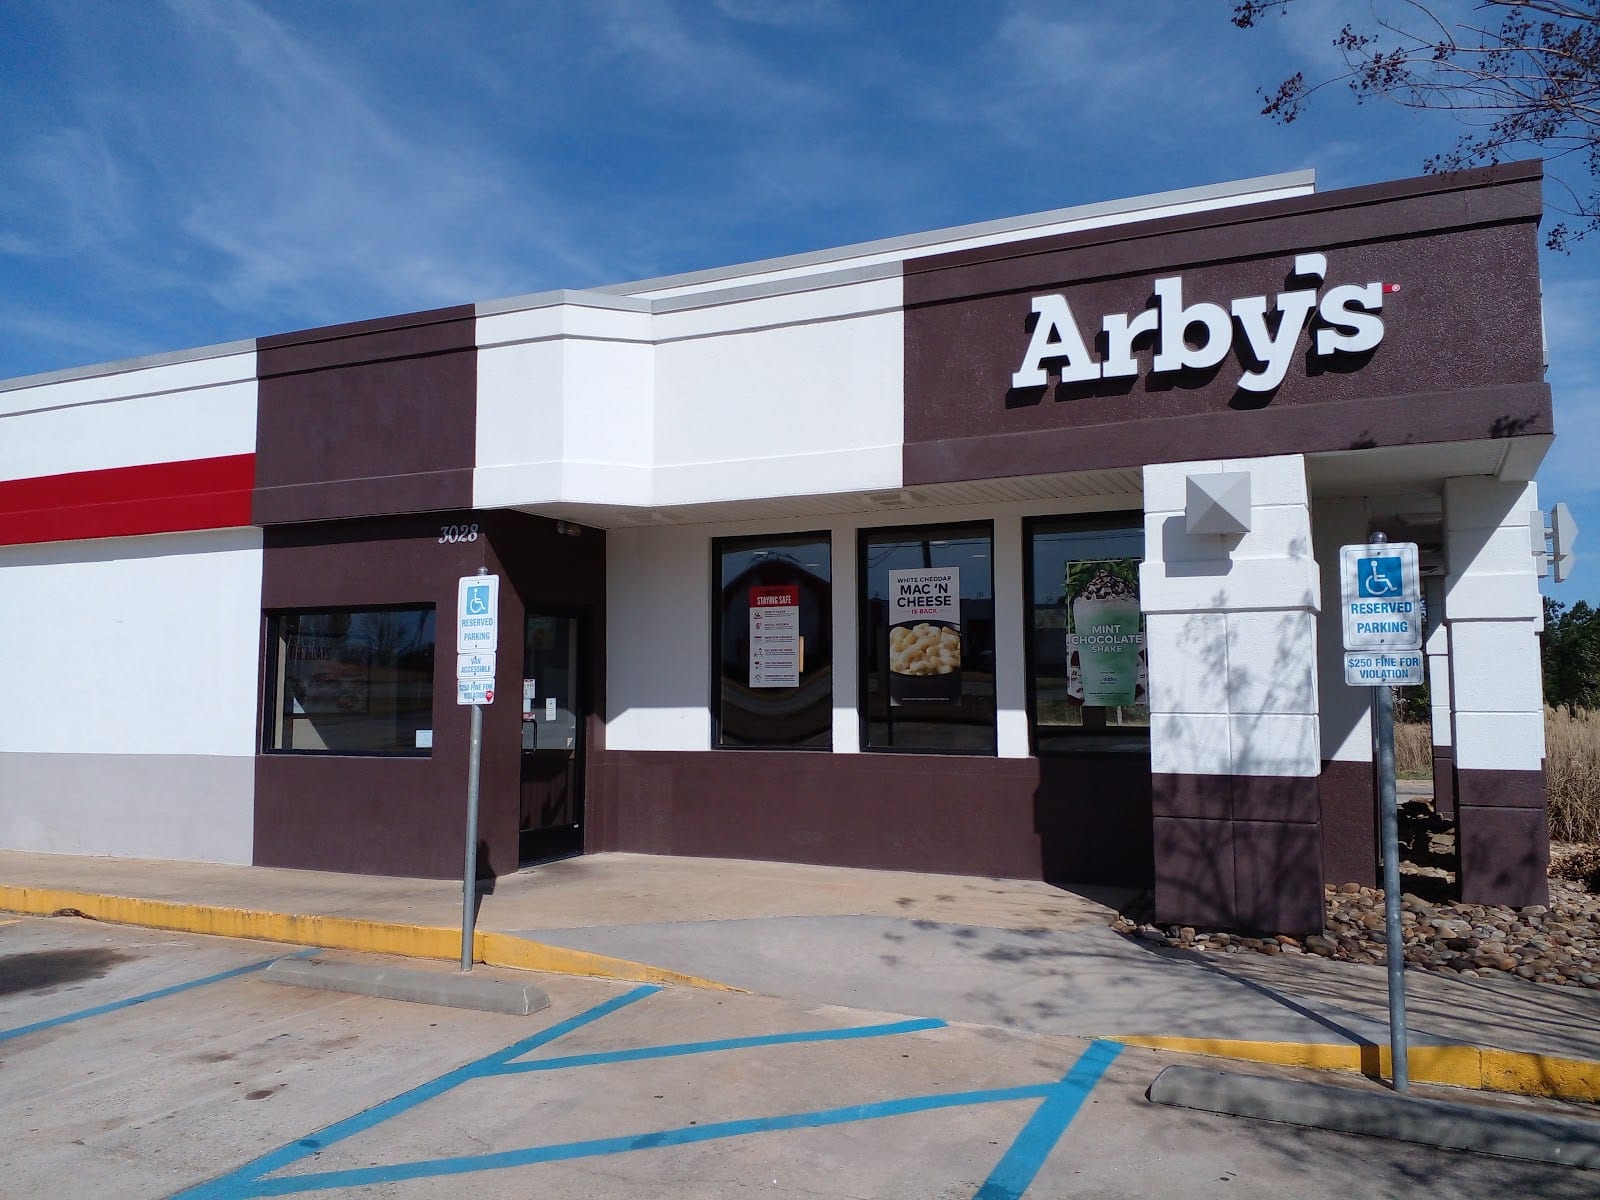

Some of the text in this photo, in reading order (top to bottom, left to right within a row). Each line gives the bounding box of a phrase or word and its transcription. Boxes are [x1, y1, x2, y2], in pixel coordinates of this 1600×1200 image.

[1012, 253, 1385, 392] Arby's
[438, 524, 479, 544] 3028
[900, 583, 948, 595] MAC 'N
[756, 595, 792, 606] STAYING SAFE
[897, 595, 952, 607] CHEESE
[1351, 602, 1413, 615] RESERVED
[461, 617, 493, 628] RESERVED
[1357, 622, 1408, 634] PARKING
[1092, 625, 1121, 634] MINT
[464, 632, 490, 641] PARKING
[1071, 634, 1143, 645] CHOCOLATE
[1091, 645, 1123, 653] SHAKE
[470, 657, 481, 665] VAN
[1348, 657, 1419, 668] $250 FINE FOR
[460, 665, 491, 674] ACCESSIBLE
[1360, 669, 1409, 678] VIOLATION
[471, 683, 482, 691] FINE
